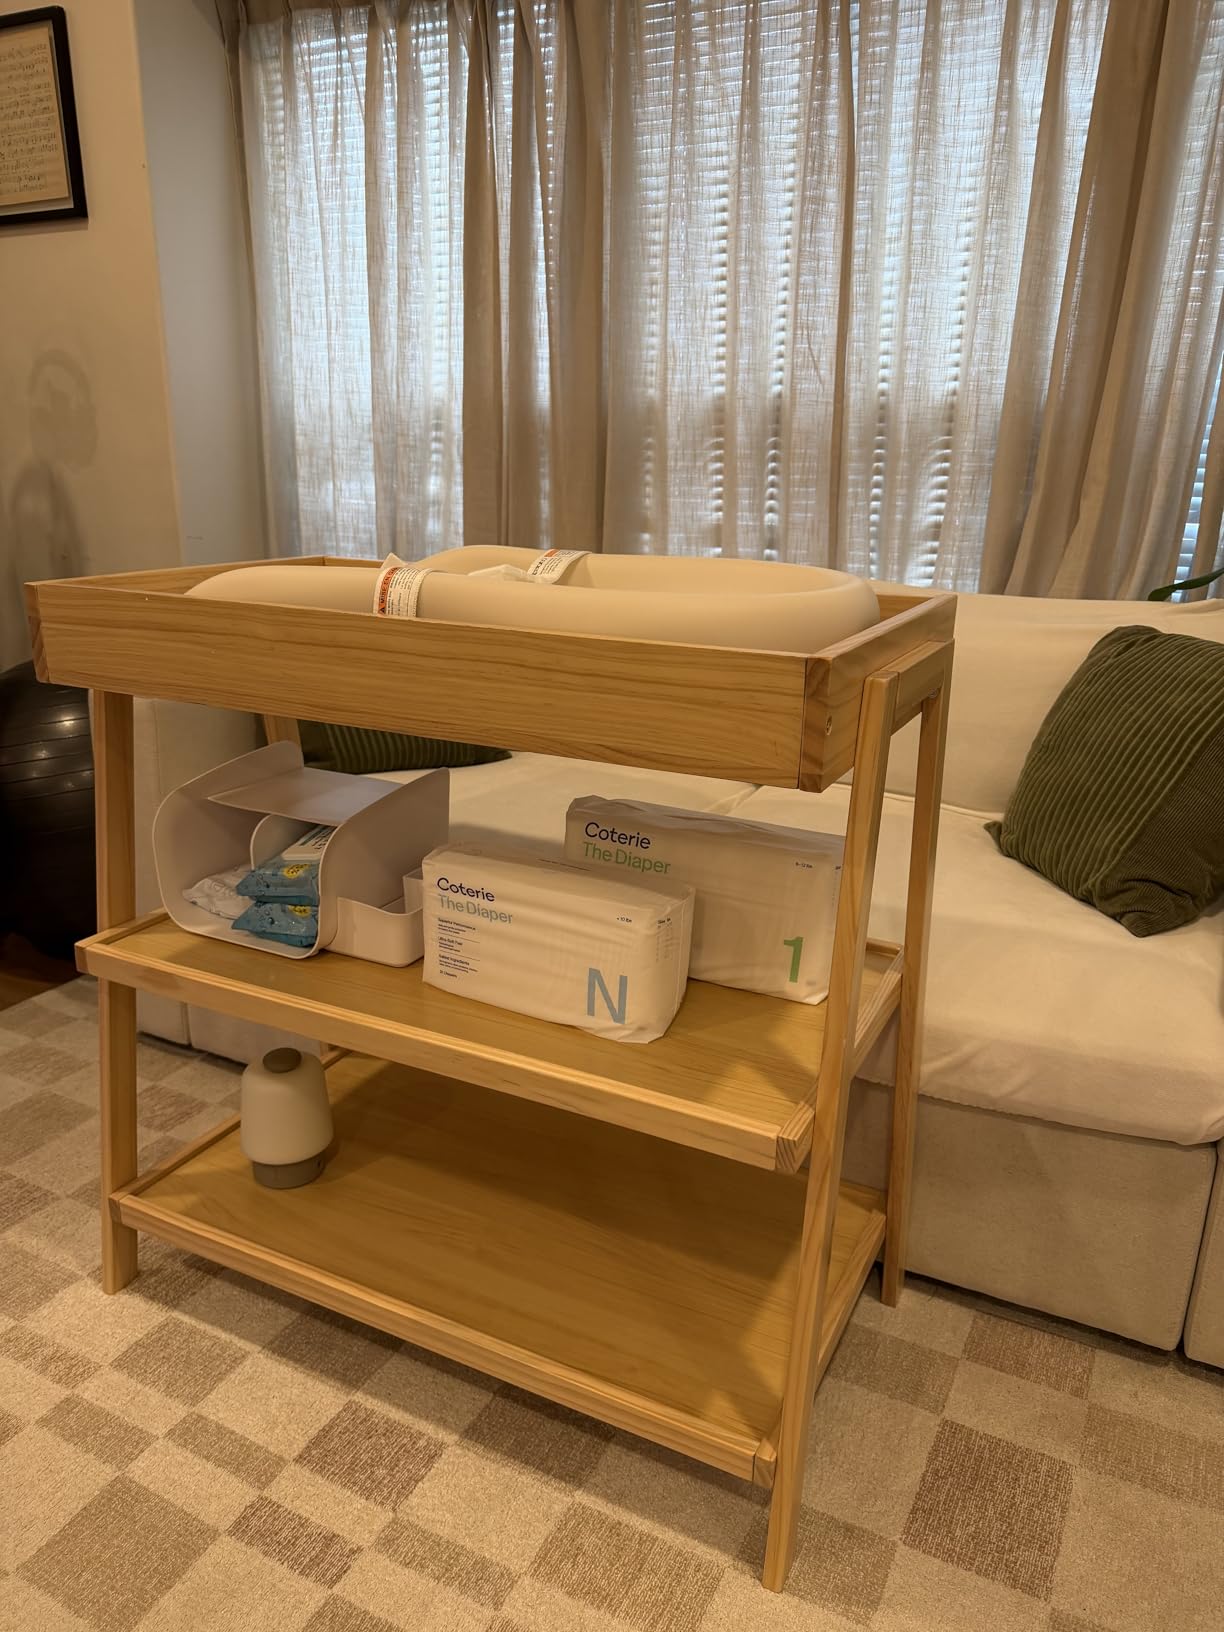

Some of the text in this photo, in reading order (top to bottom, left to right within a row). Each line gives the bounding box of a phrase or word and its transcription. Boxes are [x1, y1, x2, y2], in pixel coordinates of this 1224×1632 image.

[585, 822, 651, 849] Coterie
[583, 841, 671, 874] The Diaper
[437, 877, 495, 902] Coterie
[438, 894, 465, 912] The
[466, 901, 513, 924] Diaper
[783, 936, 804, 983] 1
[587, 967, 628, 1025] N
